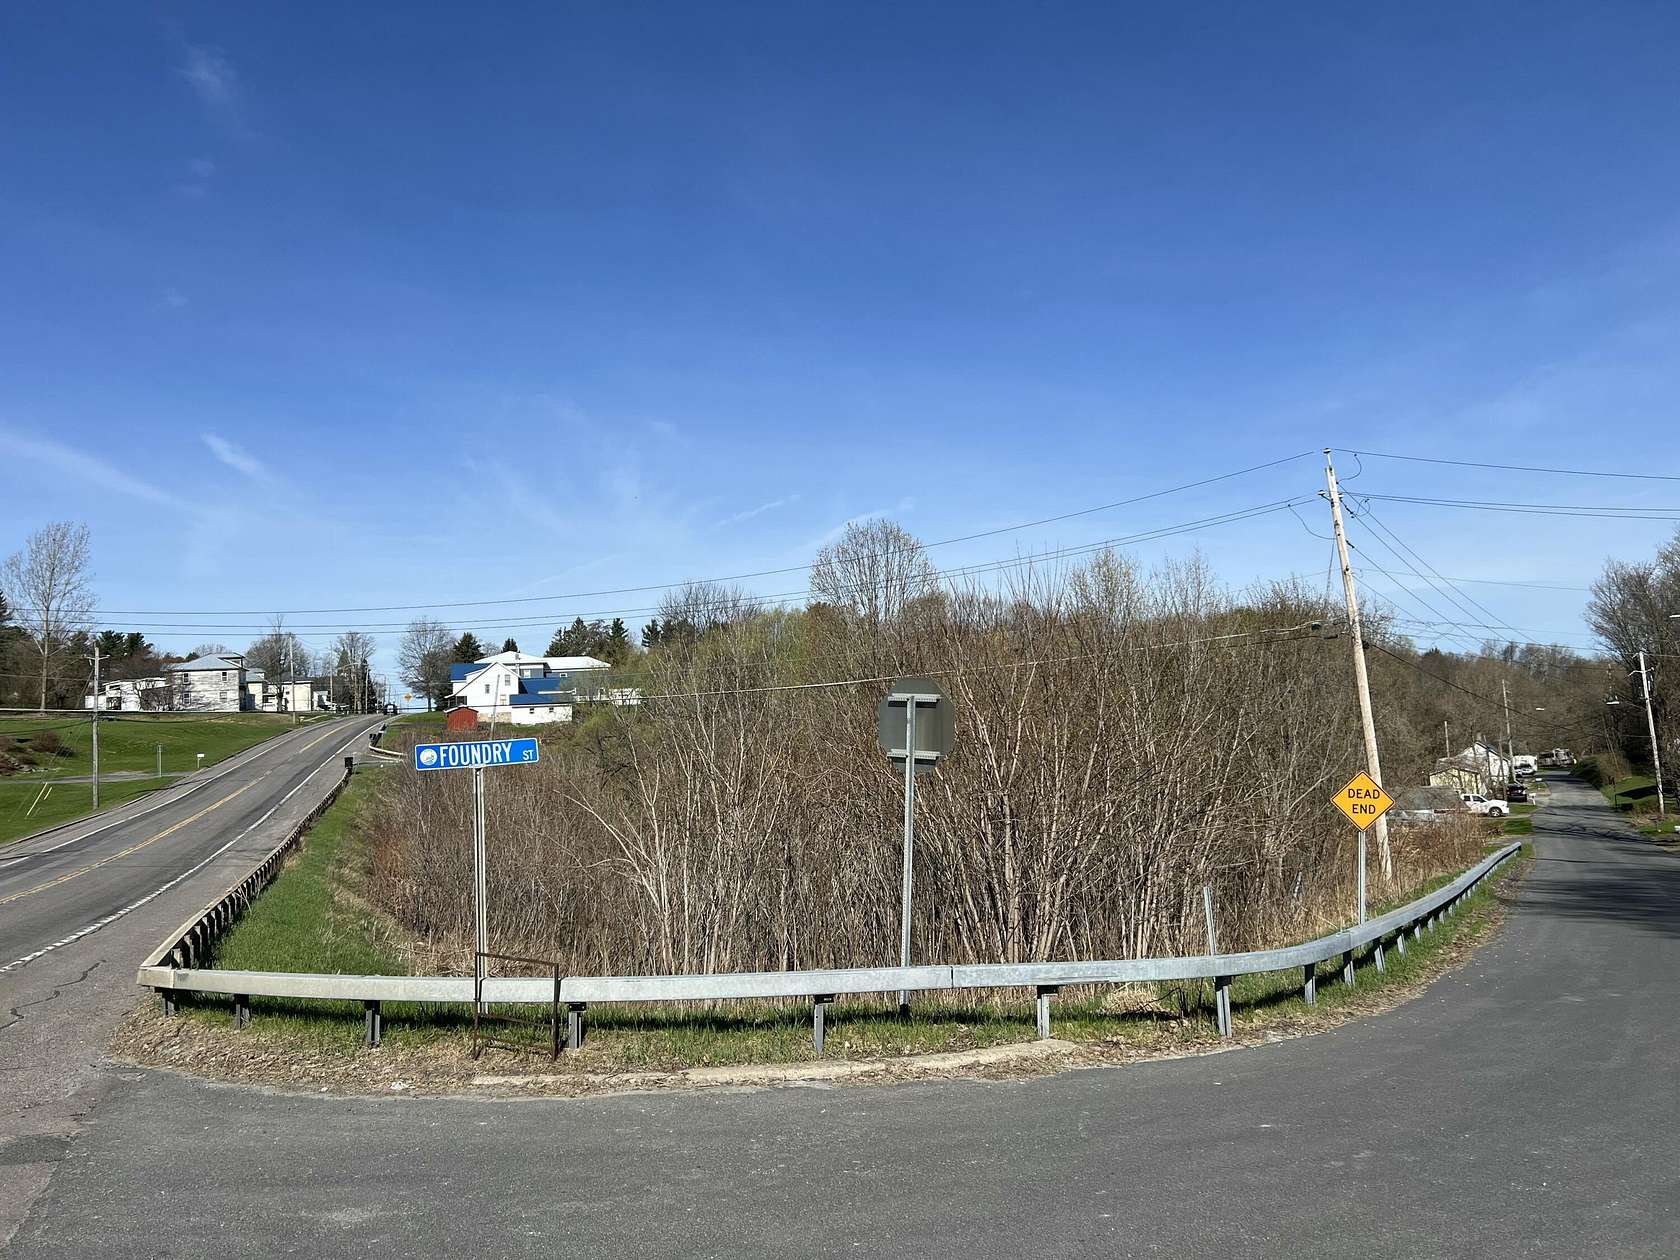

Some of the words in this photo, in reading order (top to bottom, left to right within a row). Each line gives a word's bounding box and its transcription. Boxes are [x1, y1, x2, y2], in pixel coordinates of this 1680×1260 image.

[440, 742, 512, 766] FOUNDRY
[522, 749, 534, 760] ST
[1348, 788, 1380, 799] DEAD
[1352, 804, 1376, 814] END
